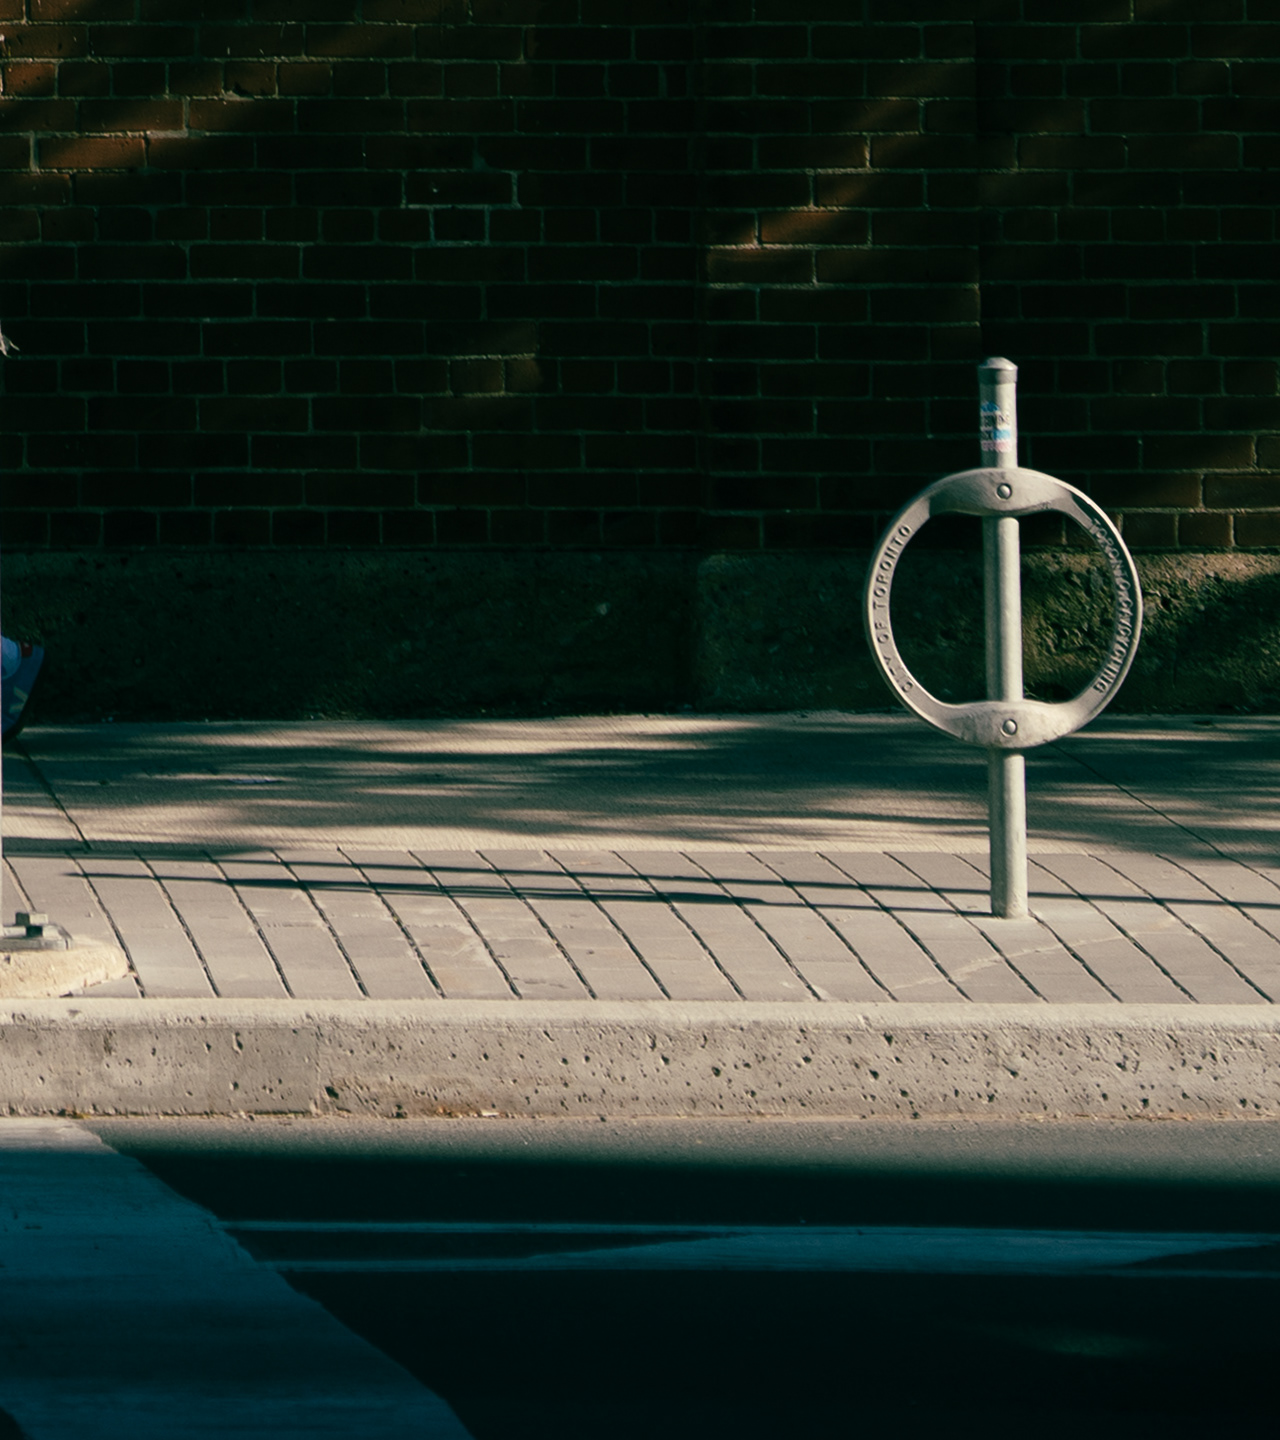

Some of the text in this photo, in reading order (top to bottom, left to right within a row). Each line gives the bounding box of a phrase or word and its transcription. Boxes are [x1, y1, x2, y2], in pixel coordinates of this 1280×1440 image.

[872, 524, 914, 693] CITY OF TORONTO
